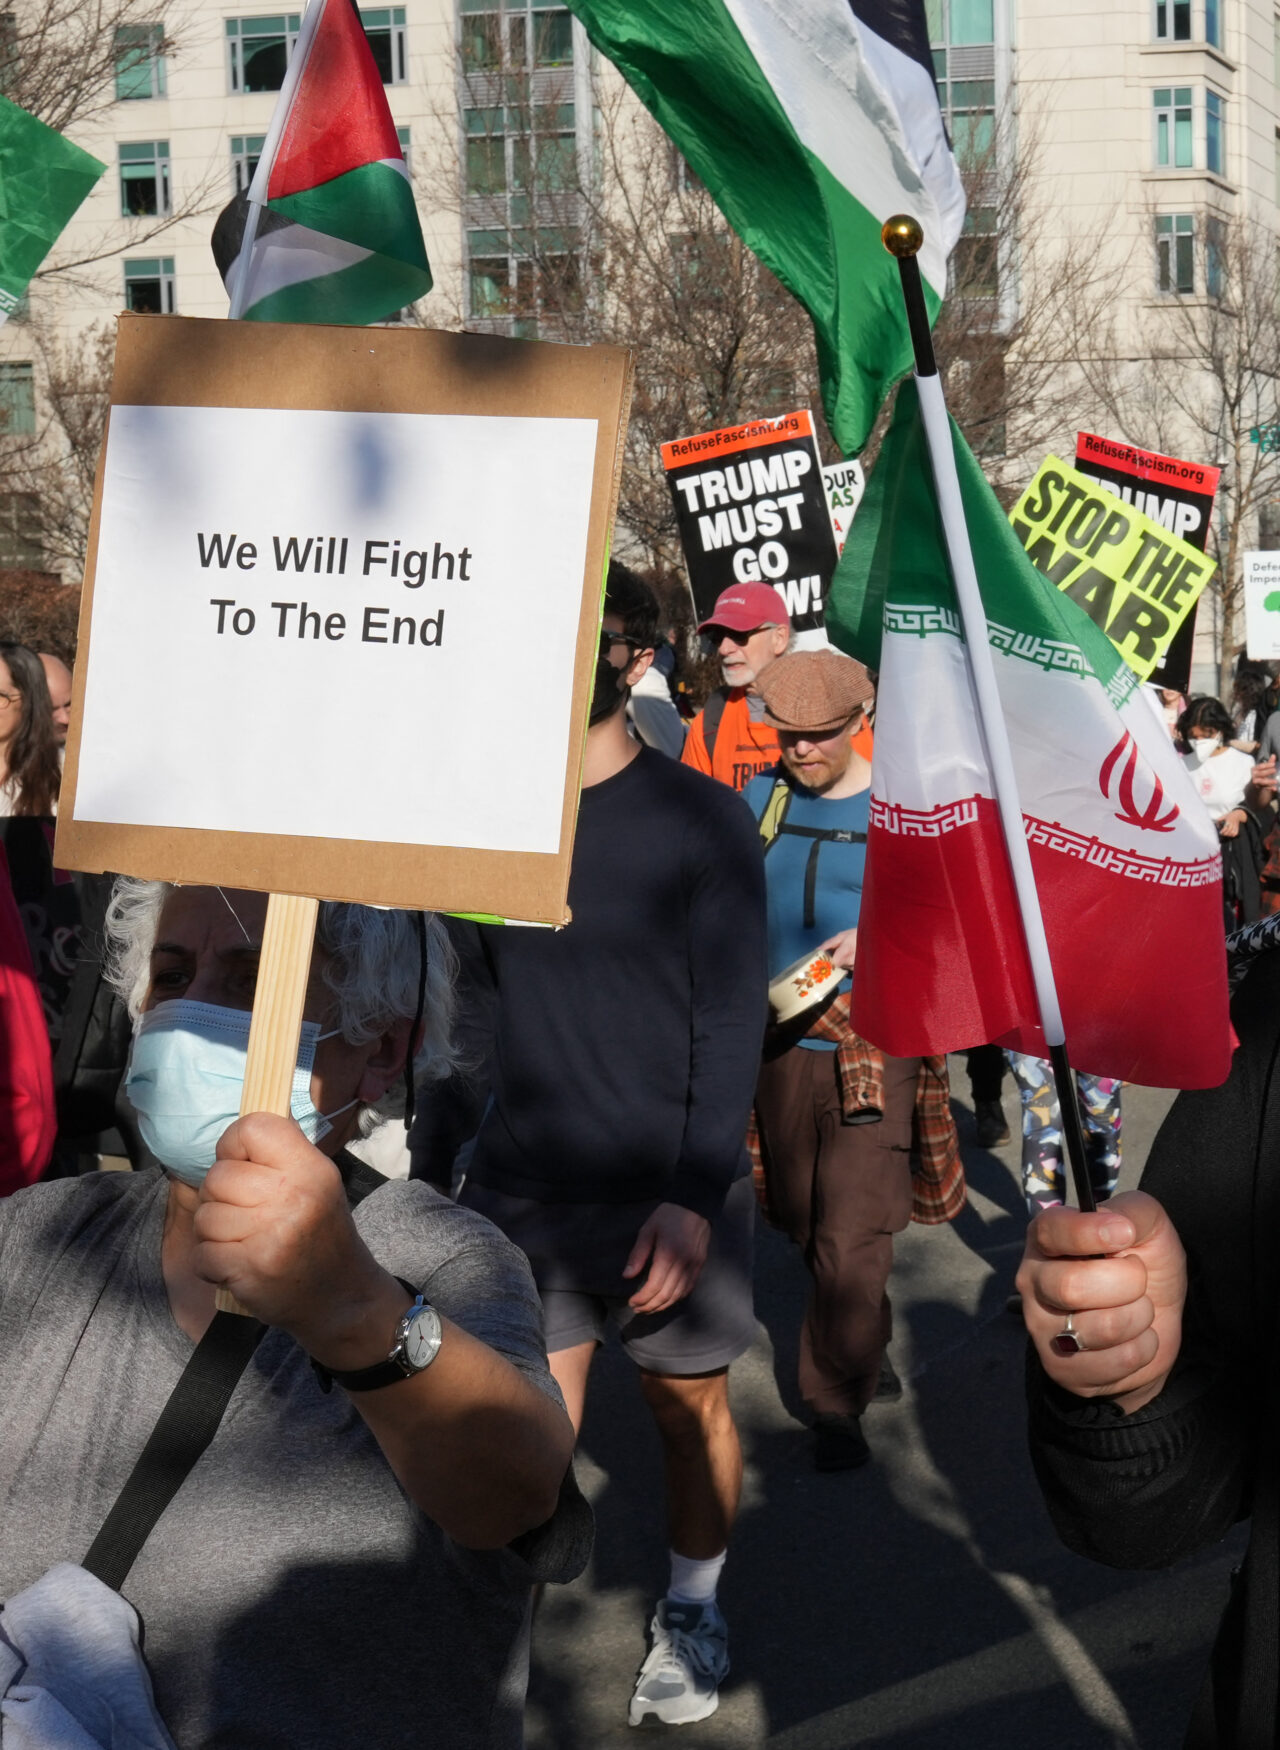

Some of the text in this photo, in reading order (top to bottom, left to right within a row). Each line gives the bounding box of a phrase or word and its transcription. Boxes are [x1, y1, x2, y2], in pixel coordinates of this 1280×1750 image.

[671, 417, 800, 457] RefuseFascism.org
[1085, 436, 1205, 484] RefuseFascism.org
[676, 450, 812, 513] TRUMP
[698, 493, 805, 553] MUST
[1023, 470, 1204, 615] STOP THE
[197, 532, 472, 588] We Will Fight
[733, 541, 789, 584] GO
[774, 575, 823, 617] W!
[1013, 517, 1170, 663] WAR
[210, 599, 445, 646] To The End
